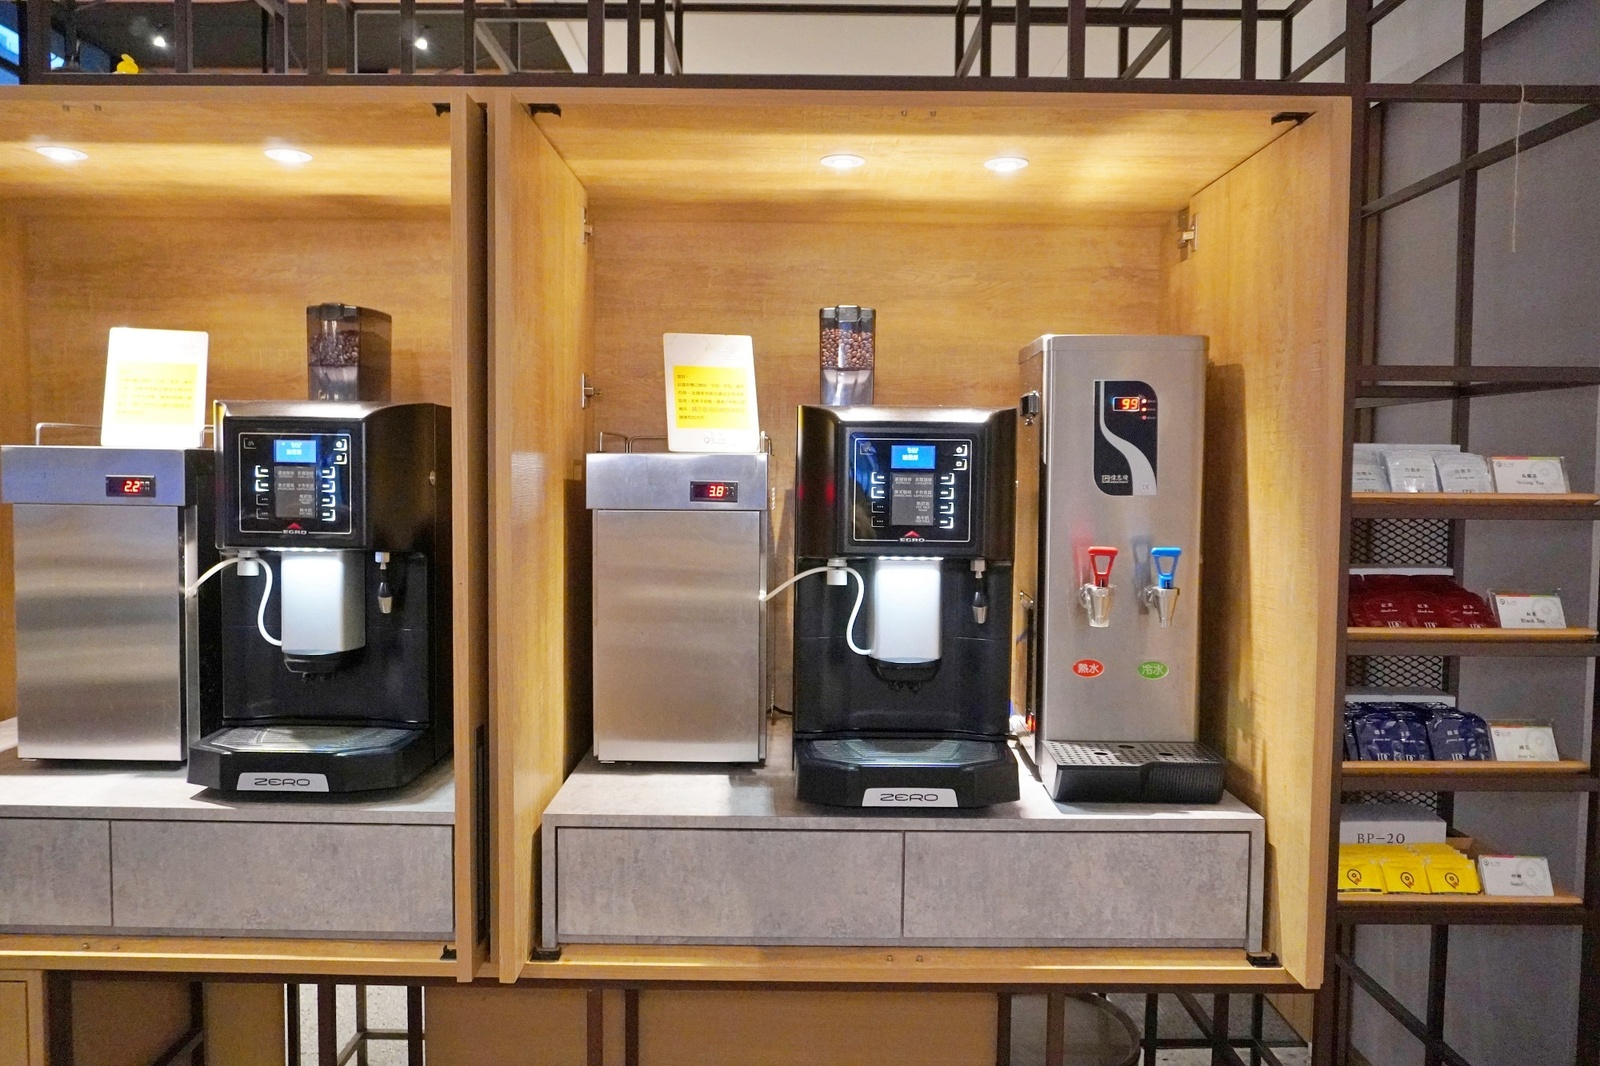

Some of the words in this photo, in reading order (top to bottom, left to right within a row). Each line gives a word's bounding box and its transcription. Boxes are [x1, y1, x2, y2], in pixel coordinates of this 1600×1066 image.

[1122, 398, 1138, 410] 99
[124, 480, 140, 492] 2.2
[709, 486, 724, 497] 3.8
[1078, 663, 1100, 674] 熱水
[1142, 664, 1164, 675] 冷水
[254, 777, 311, 786] ZERO
[880, 793, 939, 802] ZERO
